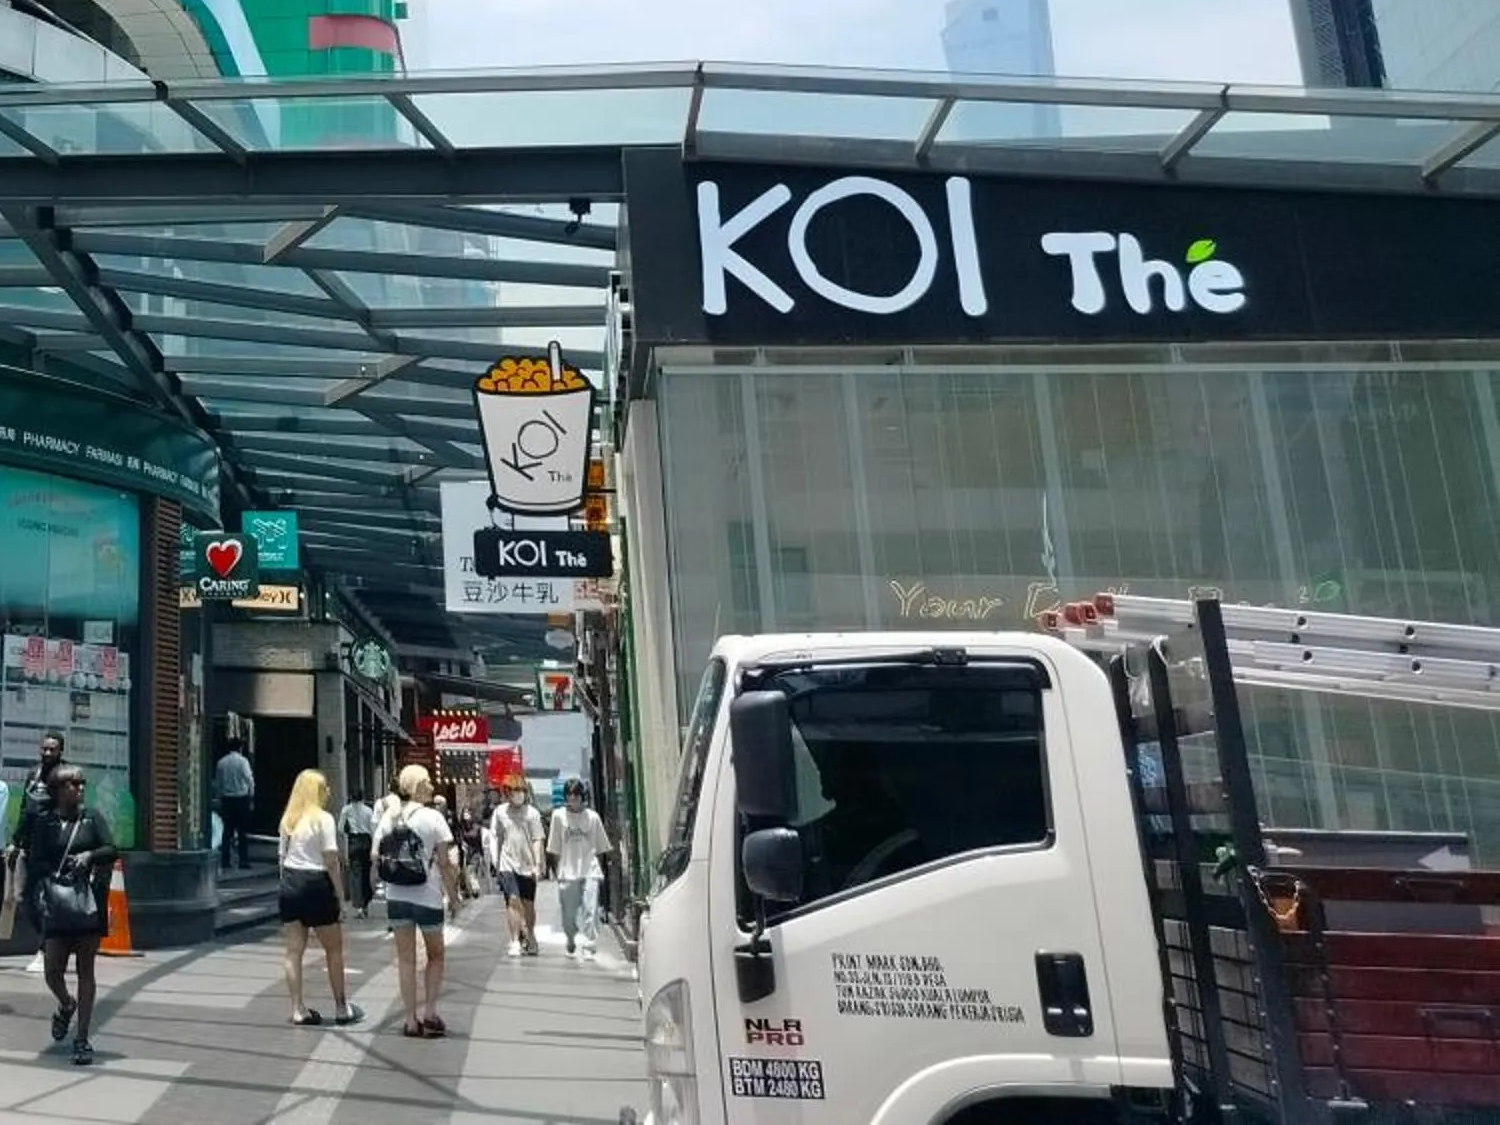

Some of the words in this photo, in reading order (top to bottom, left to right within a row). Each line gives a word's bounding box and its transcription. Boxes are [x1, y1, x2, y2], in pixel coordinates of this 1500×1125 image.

[696, 175, 989, 317] KOI
[1041, 231, 1247, 315] Thé
[23, 431, 81, 455] PHARMACY
[500, 409, 568, 482] KOI
[498, 538, 548, 568] KOI
[744, 1018, 802, 1032] NLR
[746, 1032, 804, 1046] PRO
[732, 1060, 764, 1077] BDM
[798, 1062, 820, 1080] KG
[733, 1078, 765, 1095] BTM
[800, 1080, 822, 1098] KG
